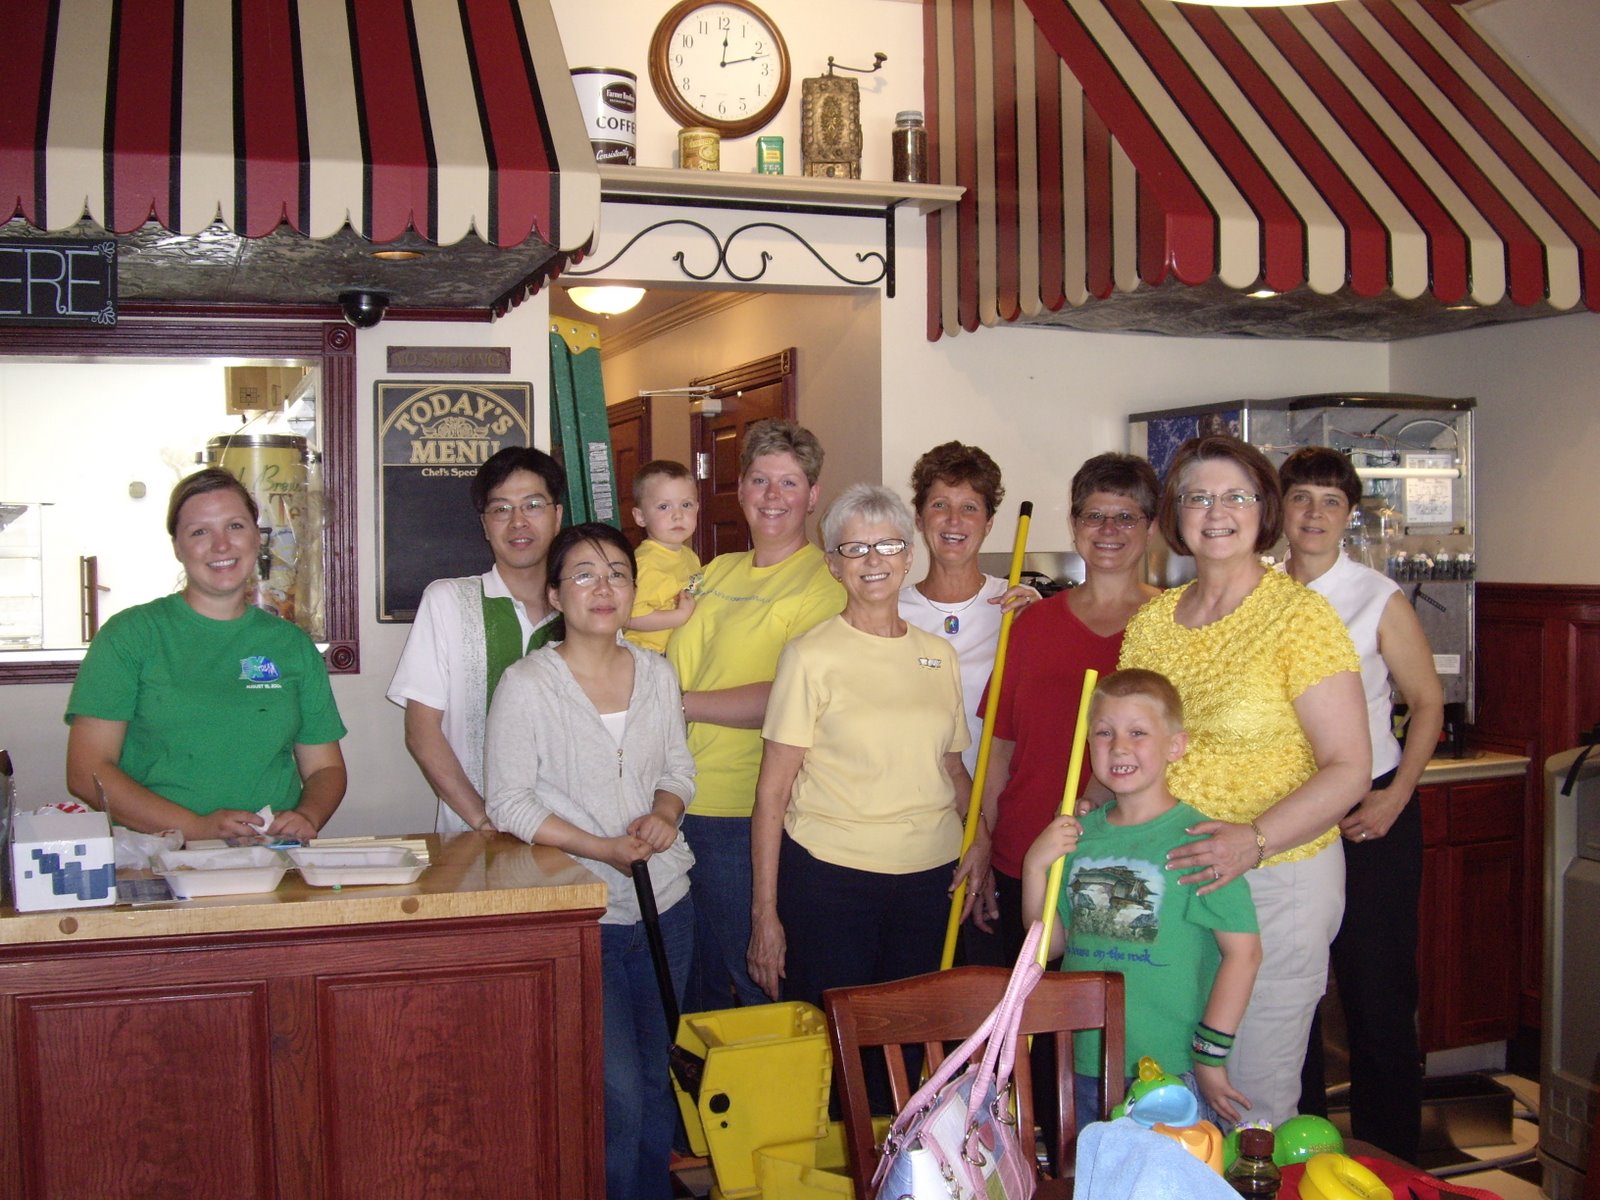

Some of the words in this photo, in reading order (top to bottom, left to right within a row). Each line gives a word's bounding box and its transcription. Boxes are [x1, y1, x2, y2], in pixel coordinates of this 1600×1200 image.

[699, 20, 708, 35] 11
[718, 16, 730, 31] 12
[682, 34, 694, 49] 10
[754, 41, 763, 55] 2
[675, 54, 684, 68] 9
[761, 62, 769, 77] 3
[682, 77, 691, 91] 8
[699, 94, 707, 108] 7
[718, 100, 727, 115] 6
[738, 97, 747, 111] 5
[394, 392, 514, 436] TODAY'S
[421, 467, 449, 477] Chef's
